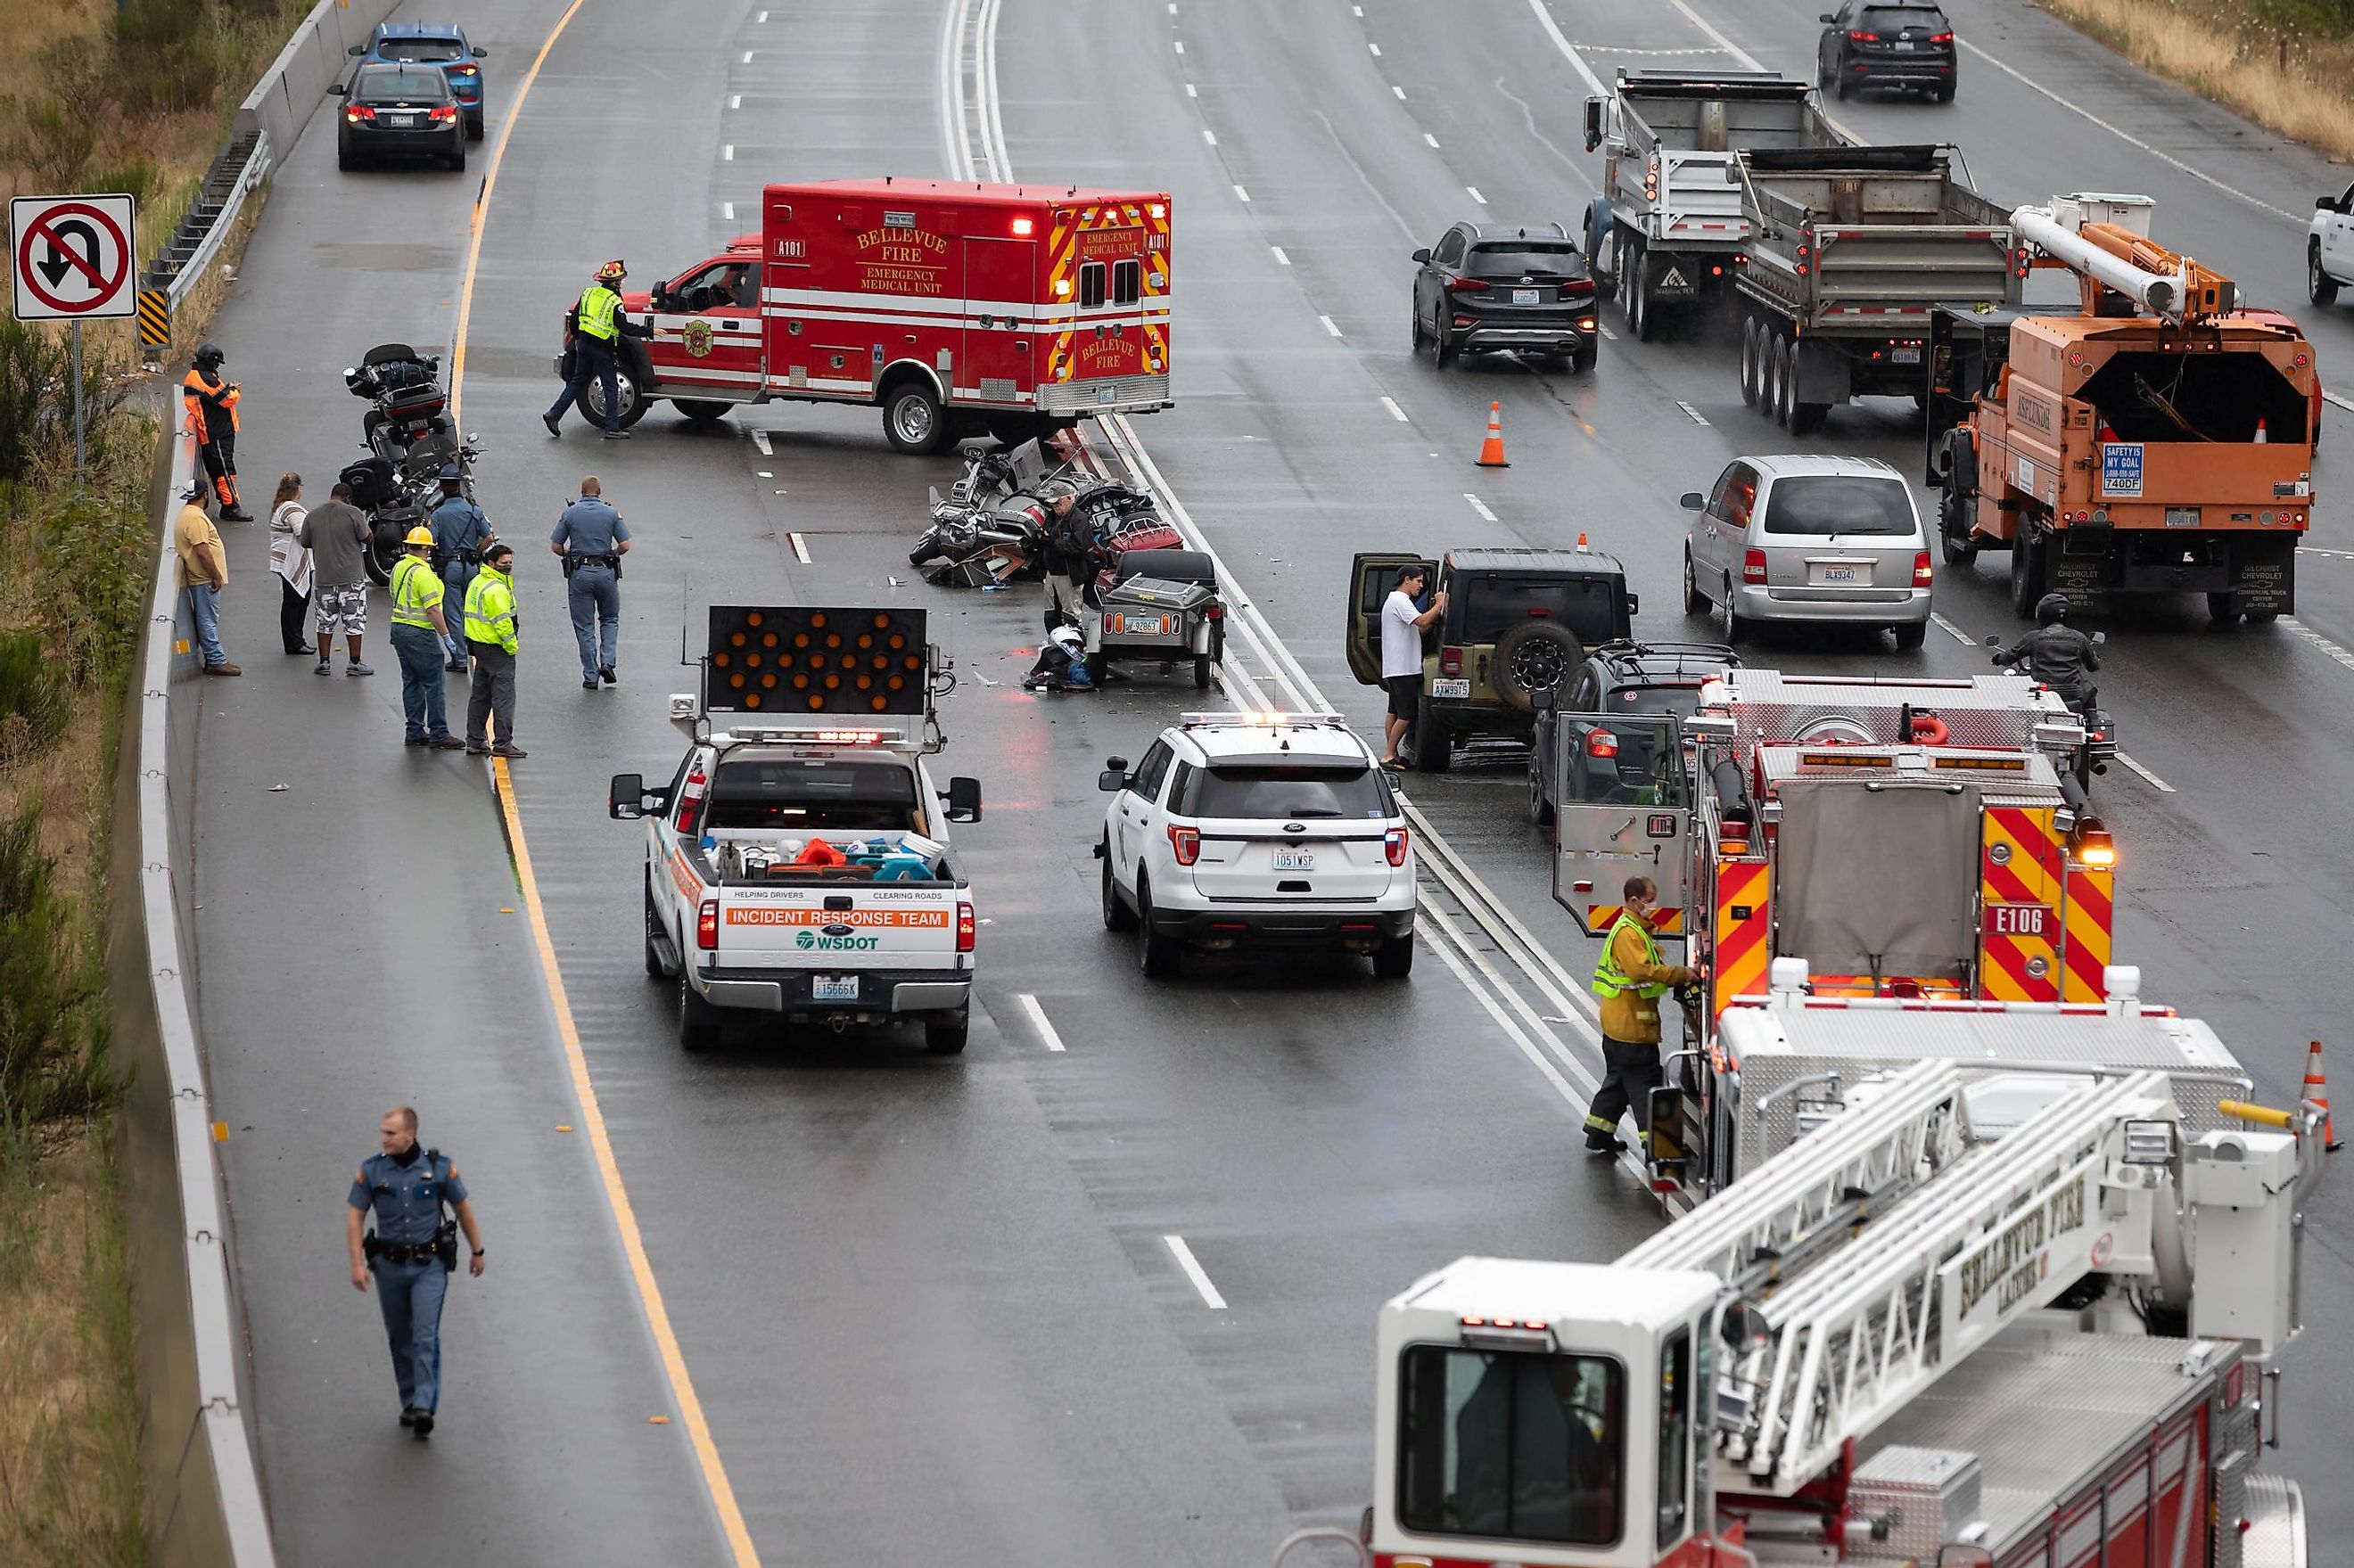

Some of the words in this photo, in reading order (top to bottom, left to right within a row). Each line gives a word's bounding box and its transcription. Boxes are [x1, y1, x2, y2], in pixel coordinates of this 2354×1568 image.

[856, 227, 947, 255] BELLEVUE
[1087, 232, 1134, 244] EMERGENCY
[1148, 234, 1165, 249] A101
[778, 241, 801, 257] A101
[882, 246, 922, 262] FIRE
[1082, 245, 1116, 256] MEDICAL
[1118, 242, 1138, 253] UNIT
[867, 267, 935, 282] EMERGENCY
[861, 279, 910, 291] MEDICAL
[915, 281, 942, 293] UNIT
[1082, 339, 1135, 361] BELLEVUE
[1096, 355, 1121, 369] FIRE
[2017, 395, 2051, 430] ASPLUNDH
[2106, 447, 2133, 456] SAFETY
[2133, 447, 2141, 456] IS
[2107, 457, 2119, 467] MY
[2121, 457, 2139, 468] GOAL
[2105, 479, 2139, 488] 740DF
[1825, 571, 1856, 579] BLX9347
[733, 910, 805, 924] INCIDENT
[811, 912, 893, 925] RESPONSE
[899, 913, 942, 925] TEAM
[1996, 908, 2042, 933] E106
[817, 937, 878, 950] WSDOT
